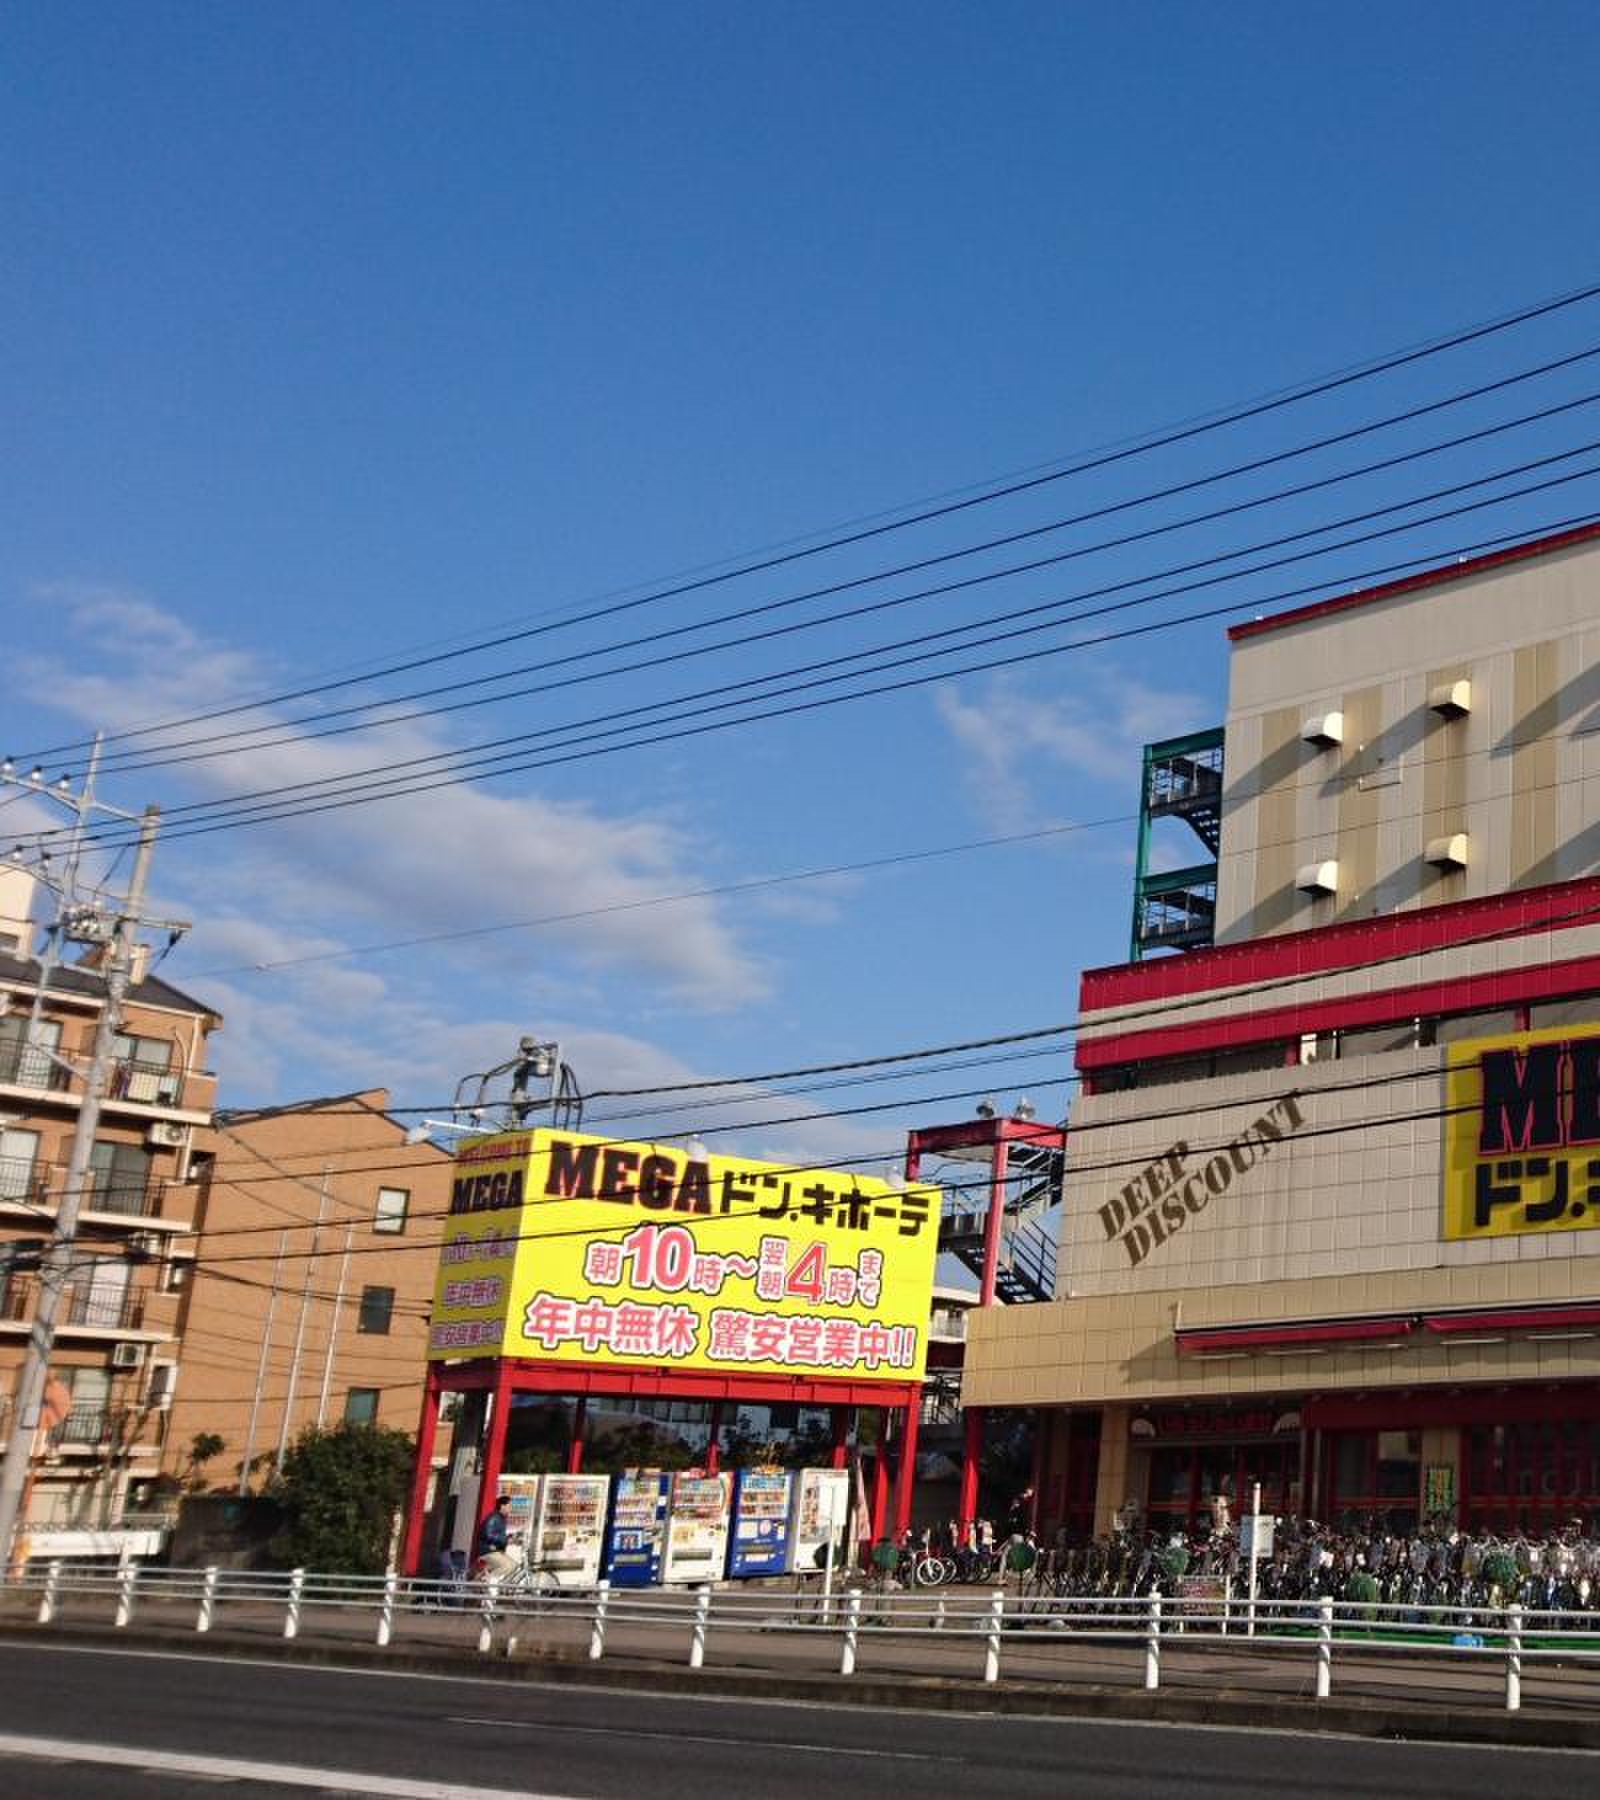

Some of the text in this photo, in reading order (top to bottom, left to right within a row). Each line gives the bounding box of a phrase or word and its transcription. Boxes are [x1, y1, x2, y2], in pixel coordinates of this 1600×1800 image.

[451, 1170, 523, 1215] MEGA
[544, 1140, 713, 1215] MEGA
[1098, 1140, 1188, 1241] DEEP
[1123, 1098, 1304, 1266] DISCOUNT
[524, 1292, 699, 1357] 年中無休
